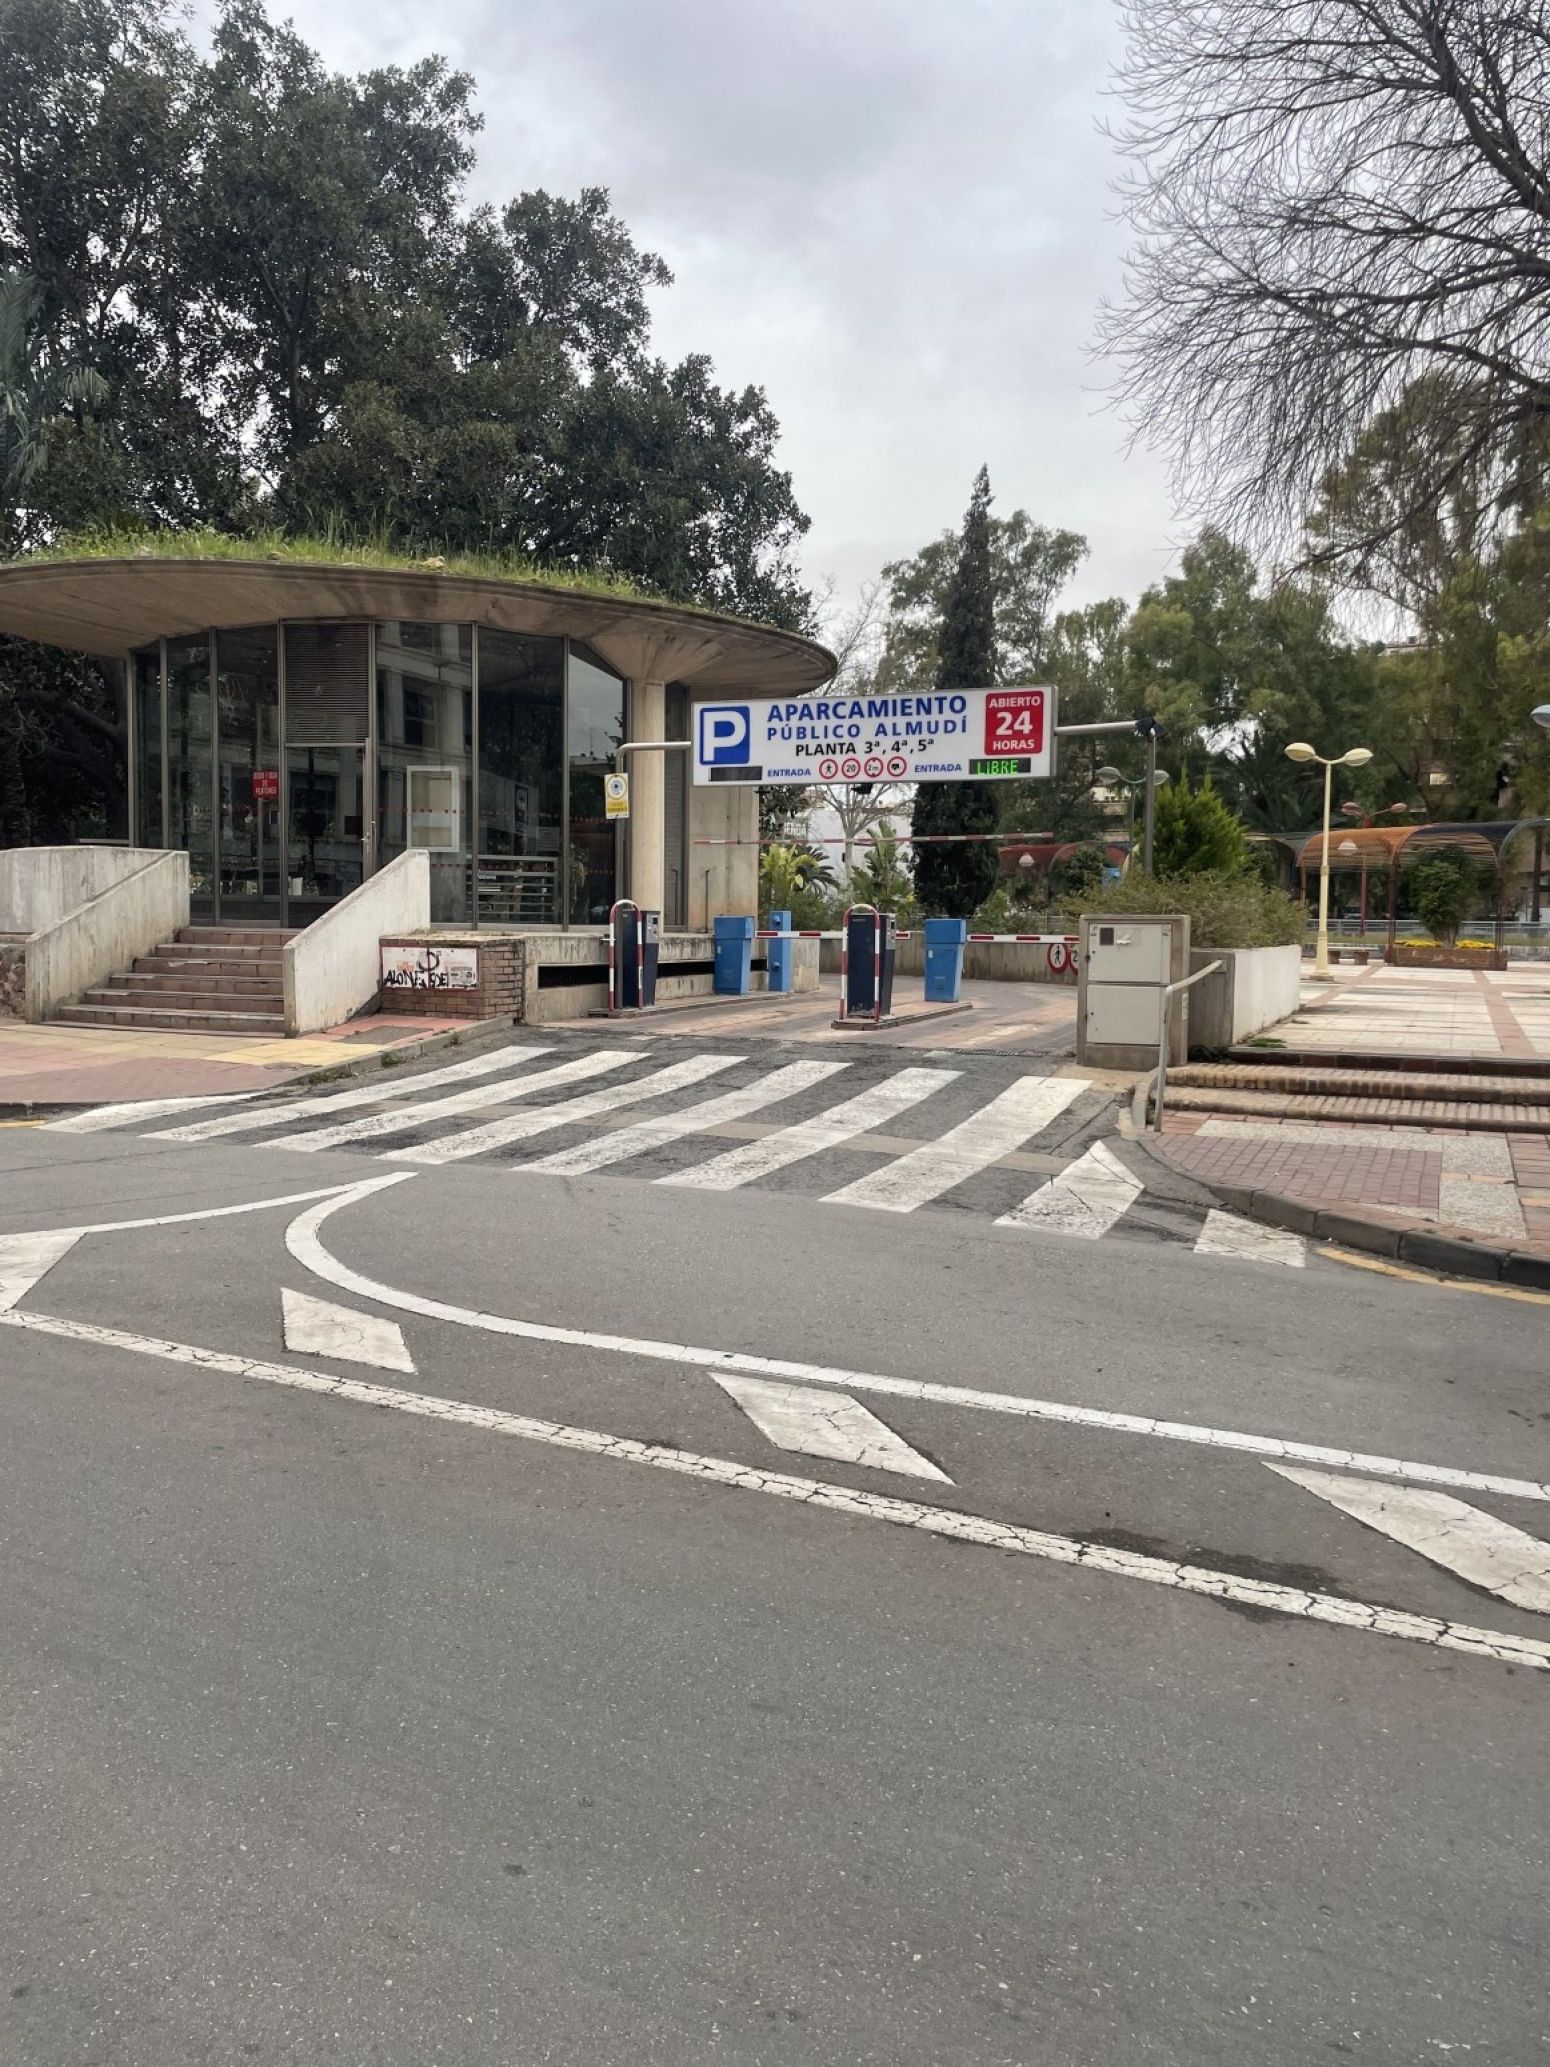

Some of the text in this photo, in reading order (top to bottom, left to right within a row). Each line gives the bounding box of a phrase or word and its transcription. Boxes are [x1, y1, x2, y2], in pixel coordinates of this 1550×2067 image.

[767, 695, 967, 722] APARCAMIENTO
[989, 696, 1041, 708] ABIERTO
[767, 715, 967, 740] PÚBLICO ALMUDÍ
[995, 710, 1033, 736] 24
[703, 711, 747, 762] P
[795, 742, 857, 756] PLANTA
[993, 739, 1035, 750] HORAS
[767, 767, 812, 777] ENTRADA
[914, 763, 962, 773] ENTRADA
[977, 760, 1019, 775] LIBRE
